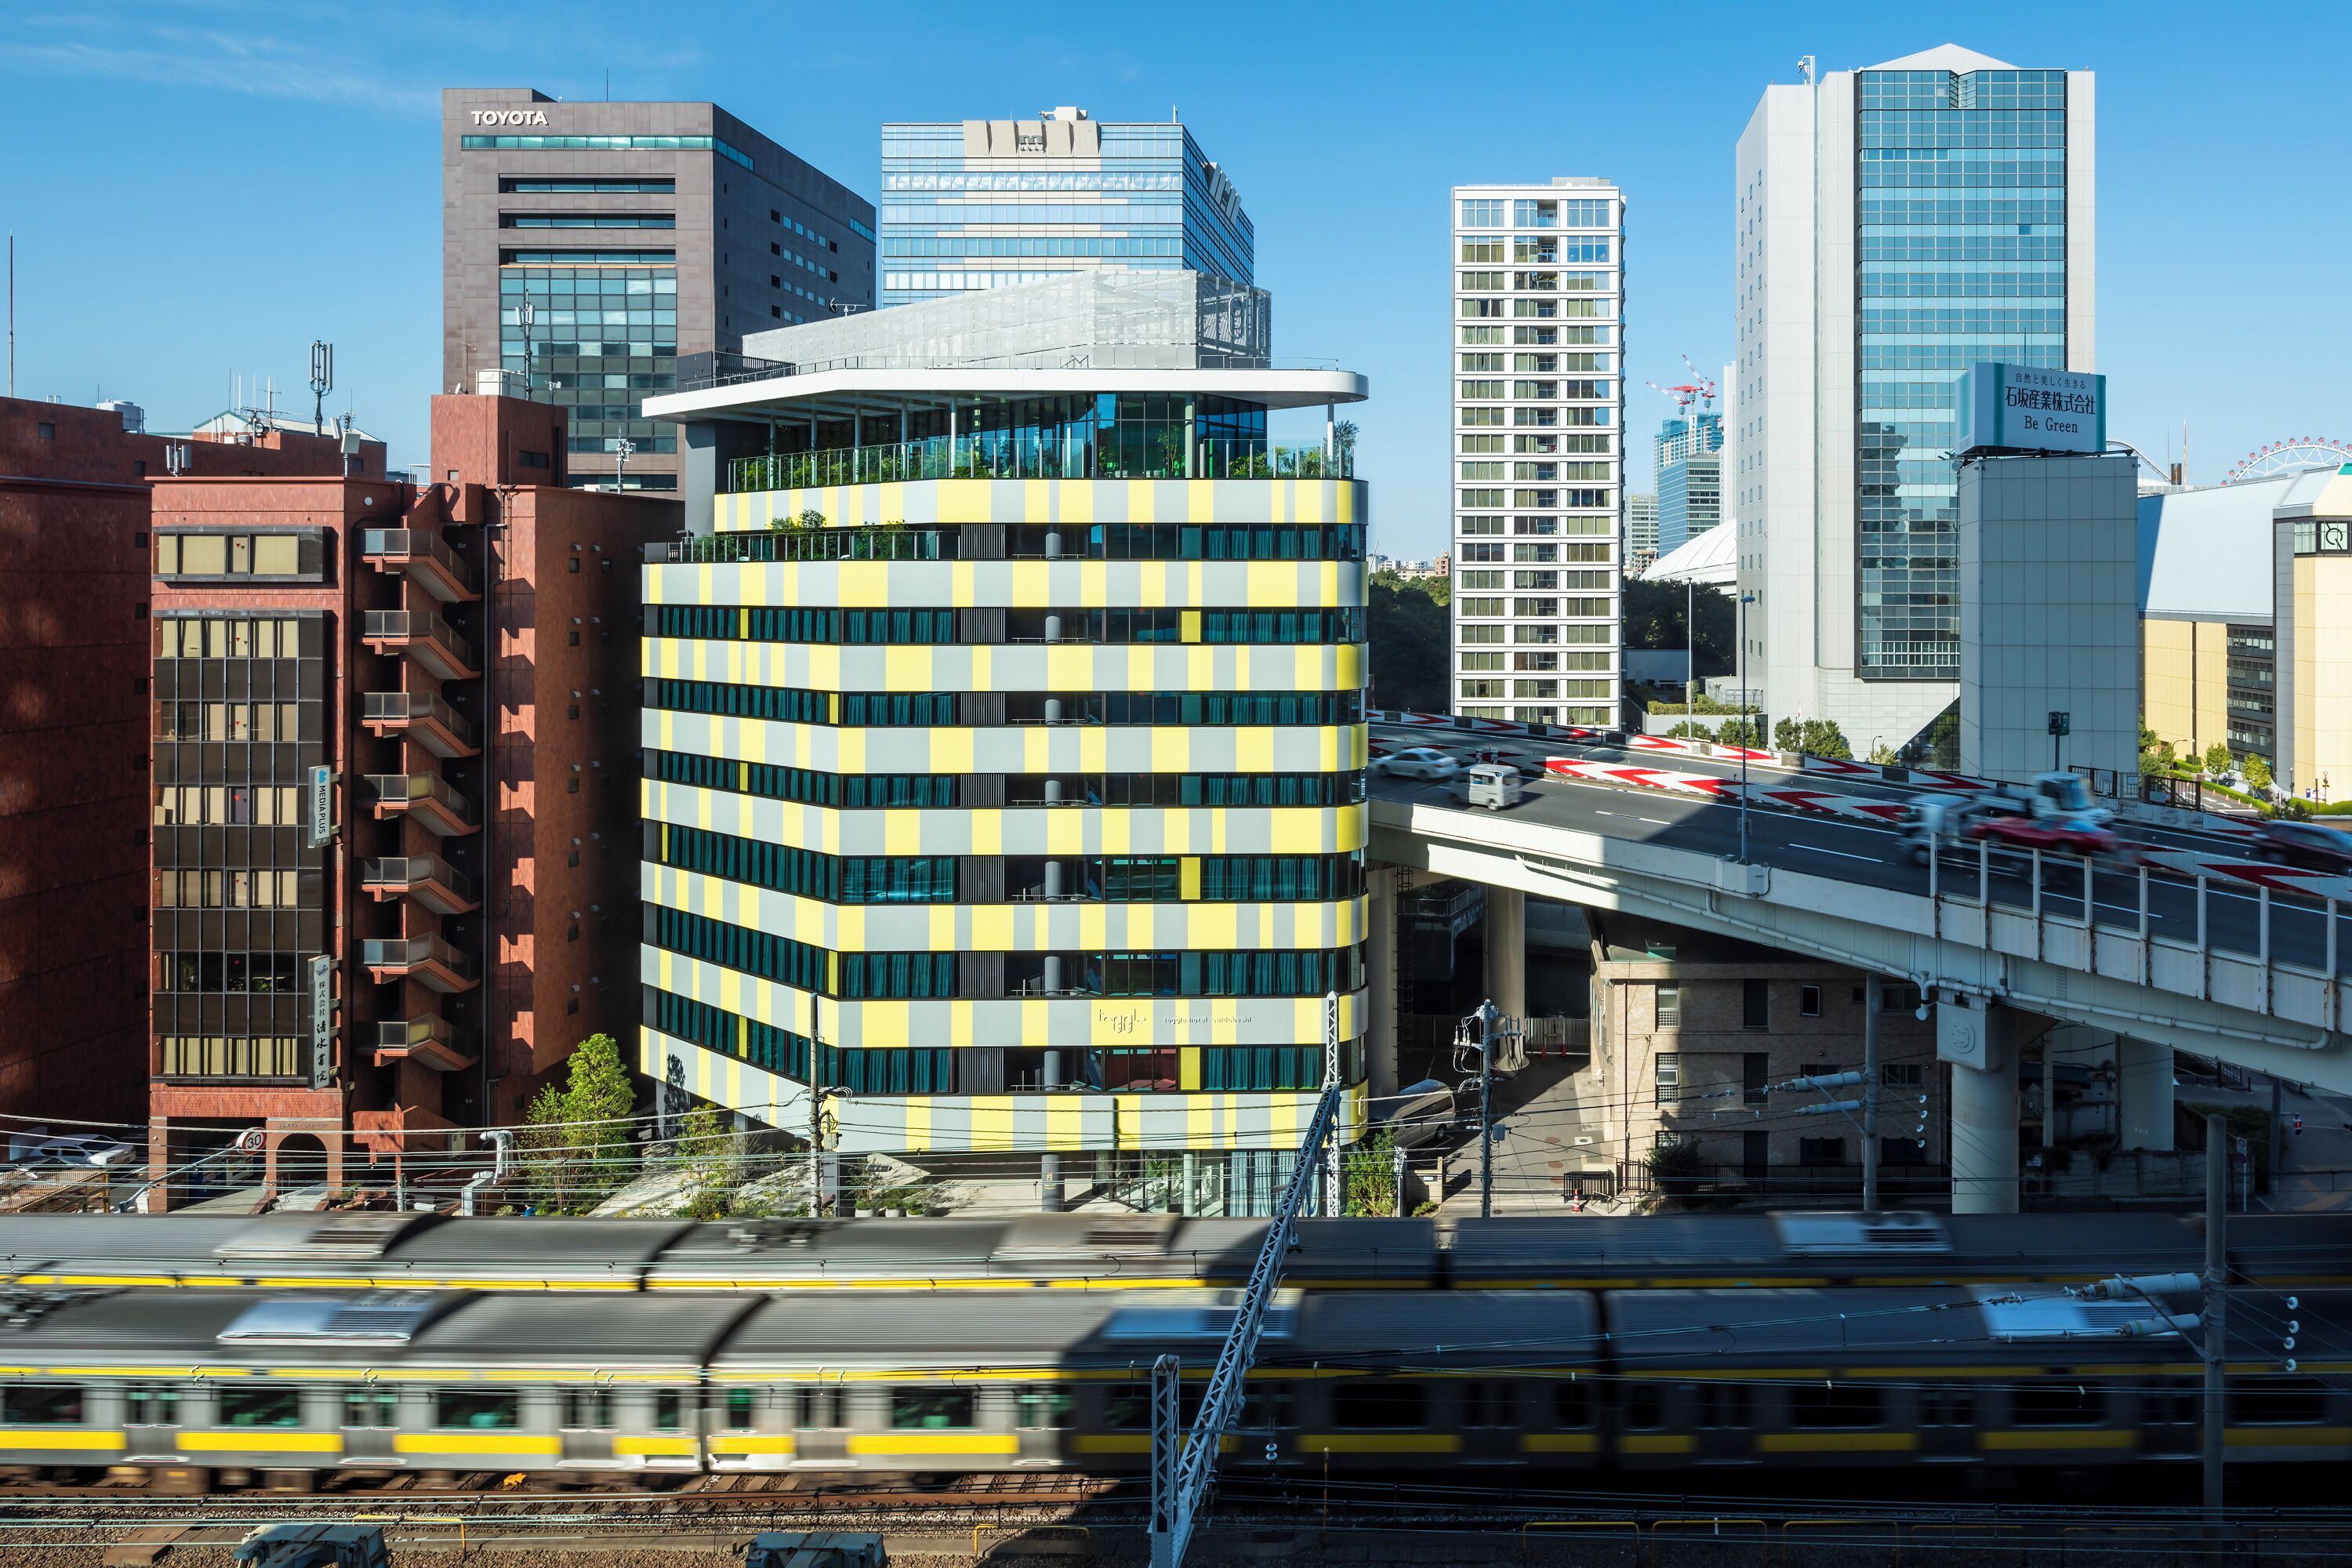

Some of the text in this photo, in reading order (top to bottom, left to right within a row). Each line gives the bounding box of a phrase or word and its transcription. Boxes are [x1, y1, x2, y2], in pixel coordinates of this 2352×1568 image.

[470, 111, 549, 125] TOYOTA
[2016, 372, 2086, 390] 自然と美しく生きる
[2005, 386, 2096, 415] 石坂産業株式会社
[2024, 416, 2078, 434] Be Green
[1098, 1008, 1147, 1034] toggle
[247, 1134, 262, 1149] 30
